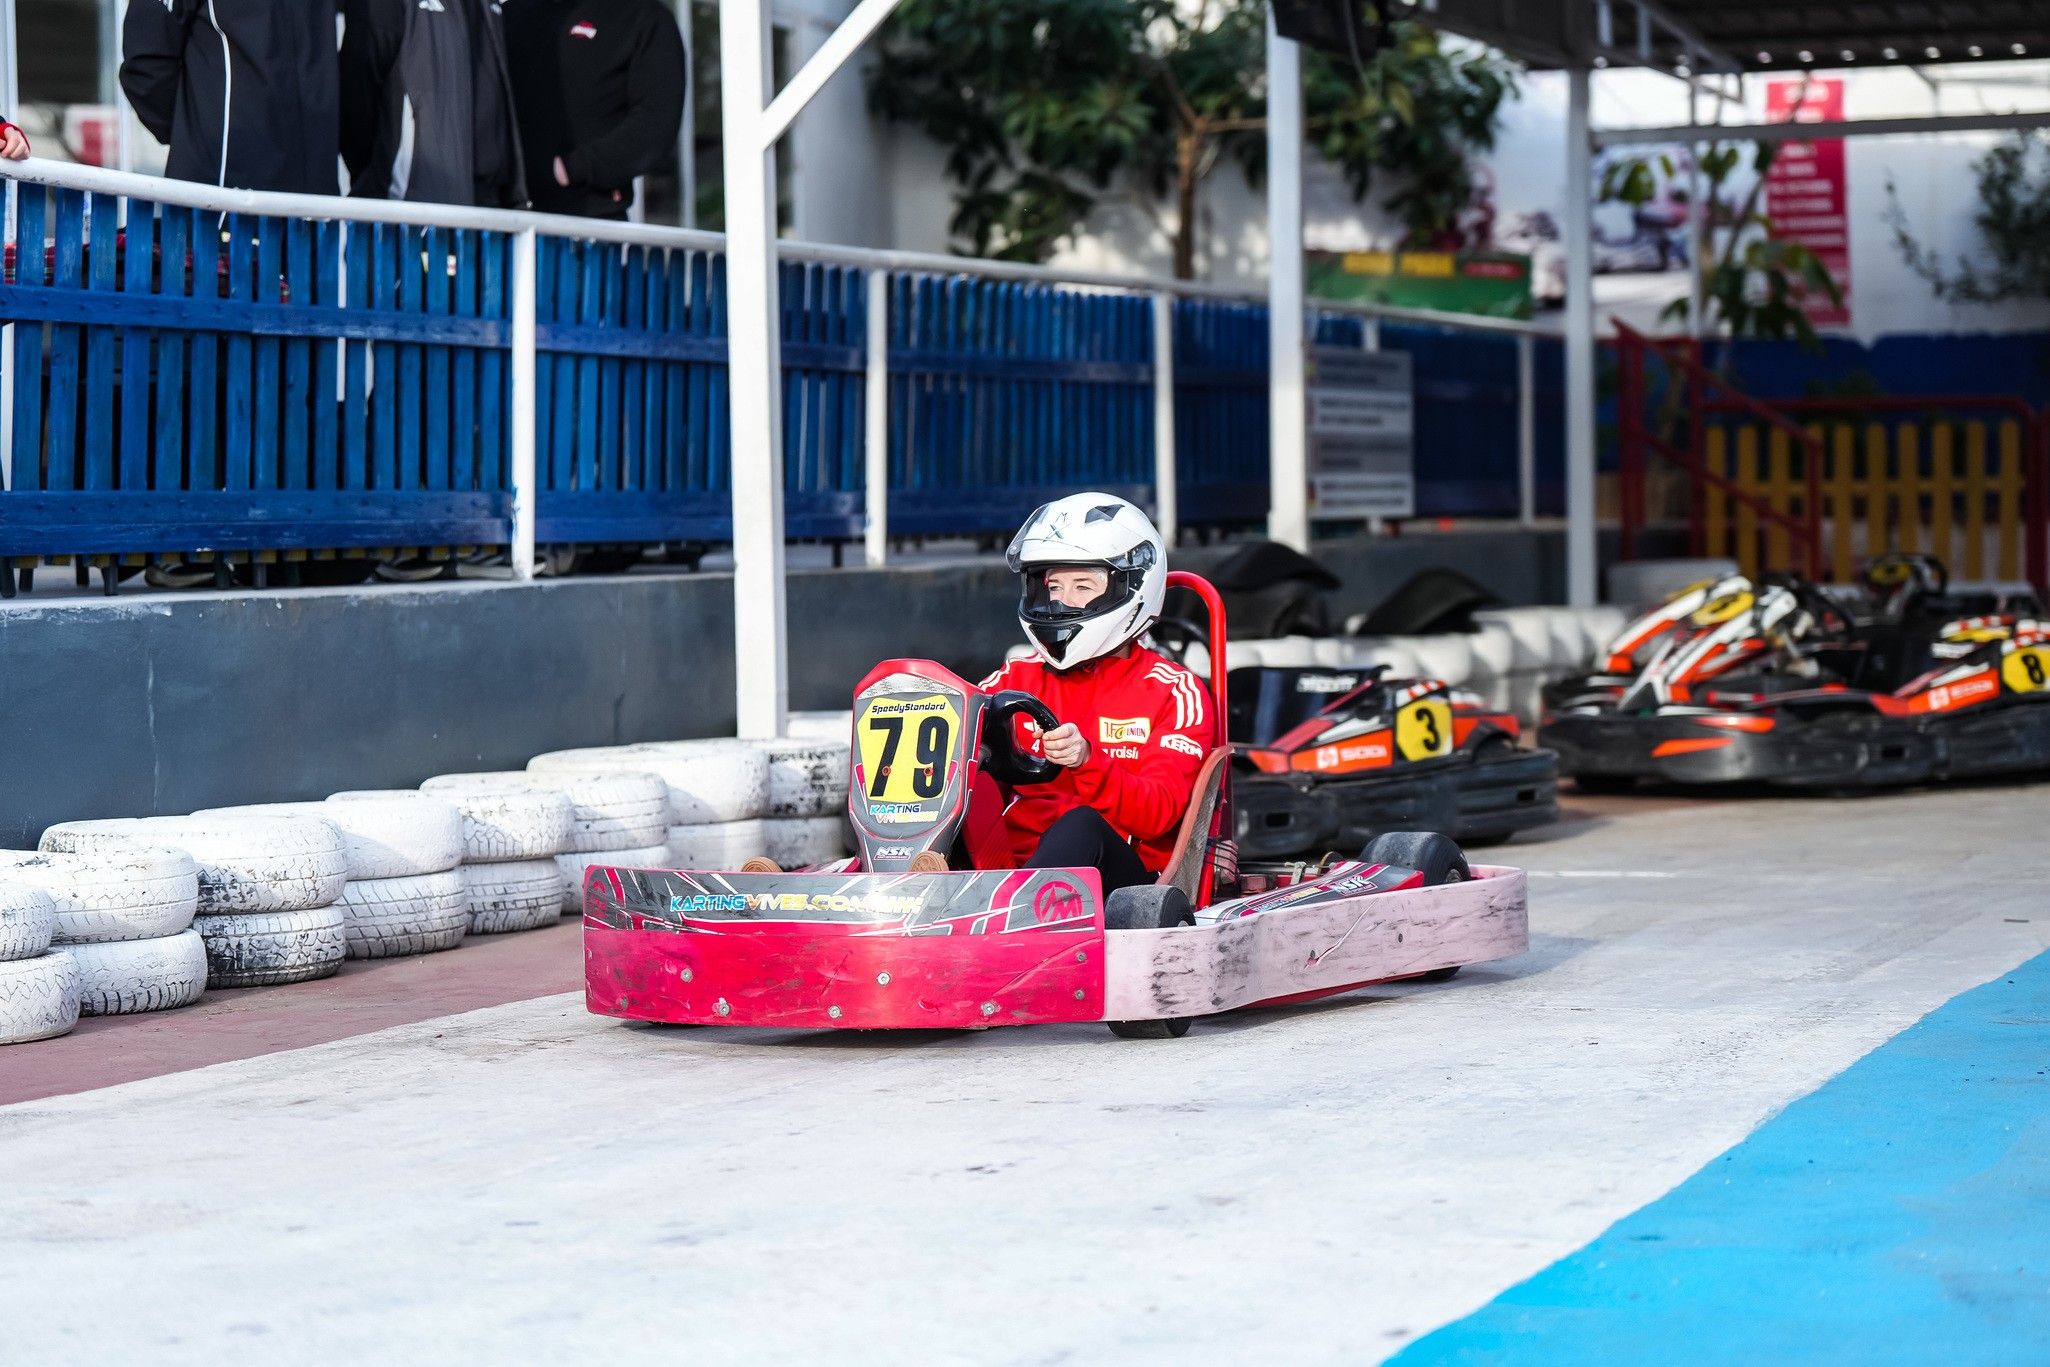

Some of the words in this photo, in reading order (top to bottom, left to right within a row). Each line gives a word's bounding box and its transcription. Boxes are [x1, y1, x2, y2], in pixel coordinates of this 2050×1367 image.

[2021, 654, 2045, 685] 8
[872, 702, 946, 714] SpeedyStandard
[1416, 708, 1441, 752] 3
[870, 716, 950, 798] 79
[870, 804, 921, 815] KARTING
